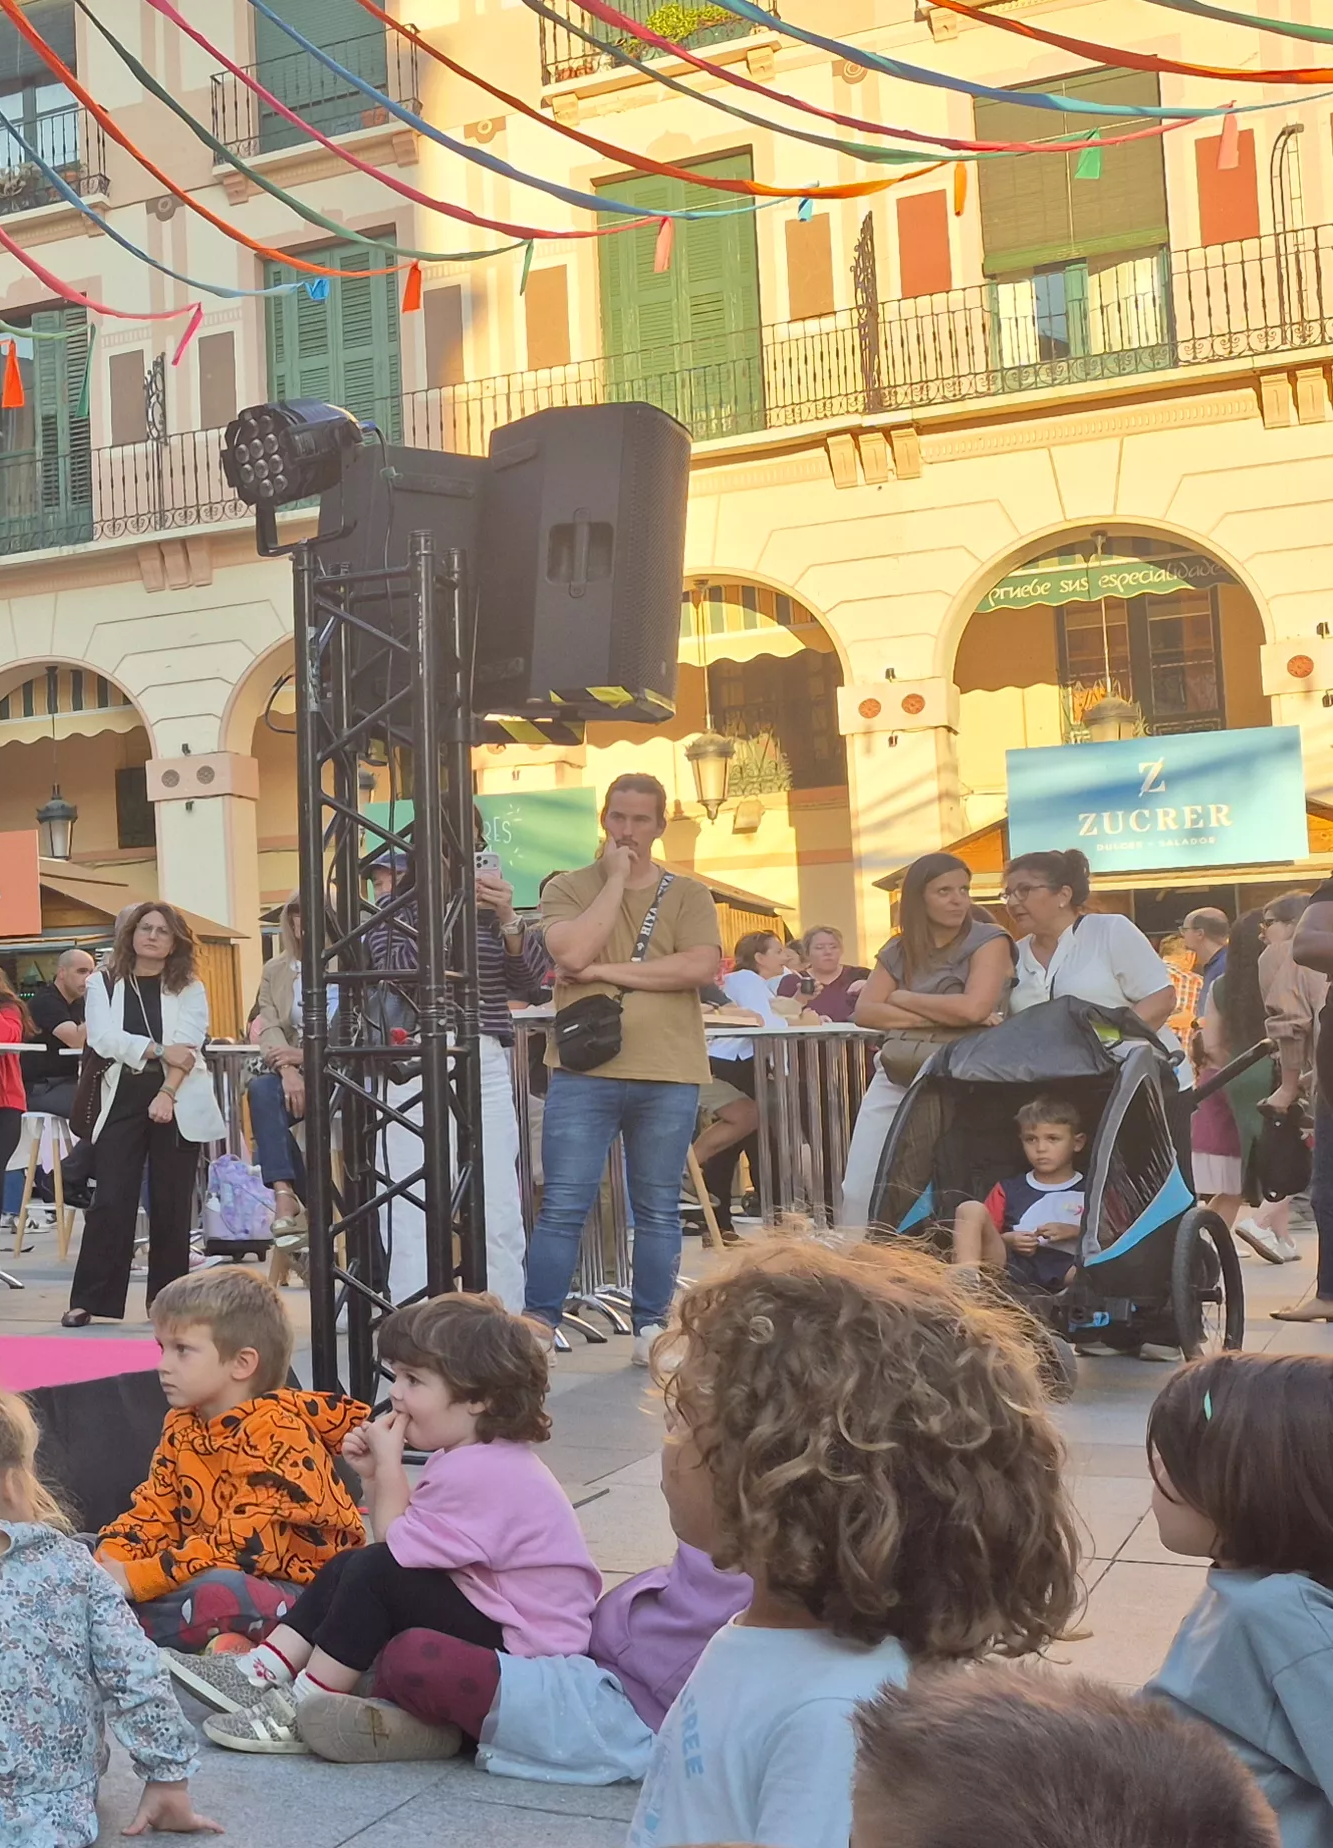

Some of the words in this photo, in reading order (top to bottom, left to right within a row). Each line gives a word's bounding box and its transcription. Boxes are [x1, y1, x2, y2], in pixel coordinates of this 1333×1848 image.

[988, 578, 1051, 607] pruebe
[1059, 576, 1089, 594] sus
[1078, 804, 1233, 836] ZUCRER
